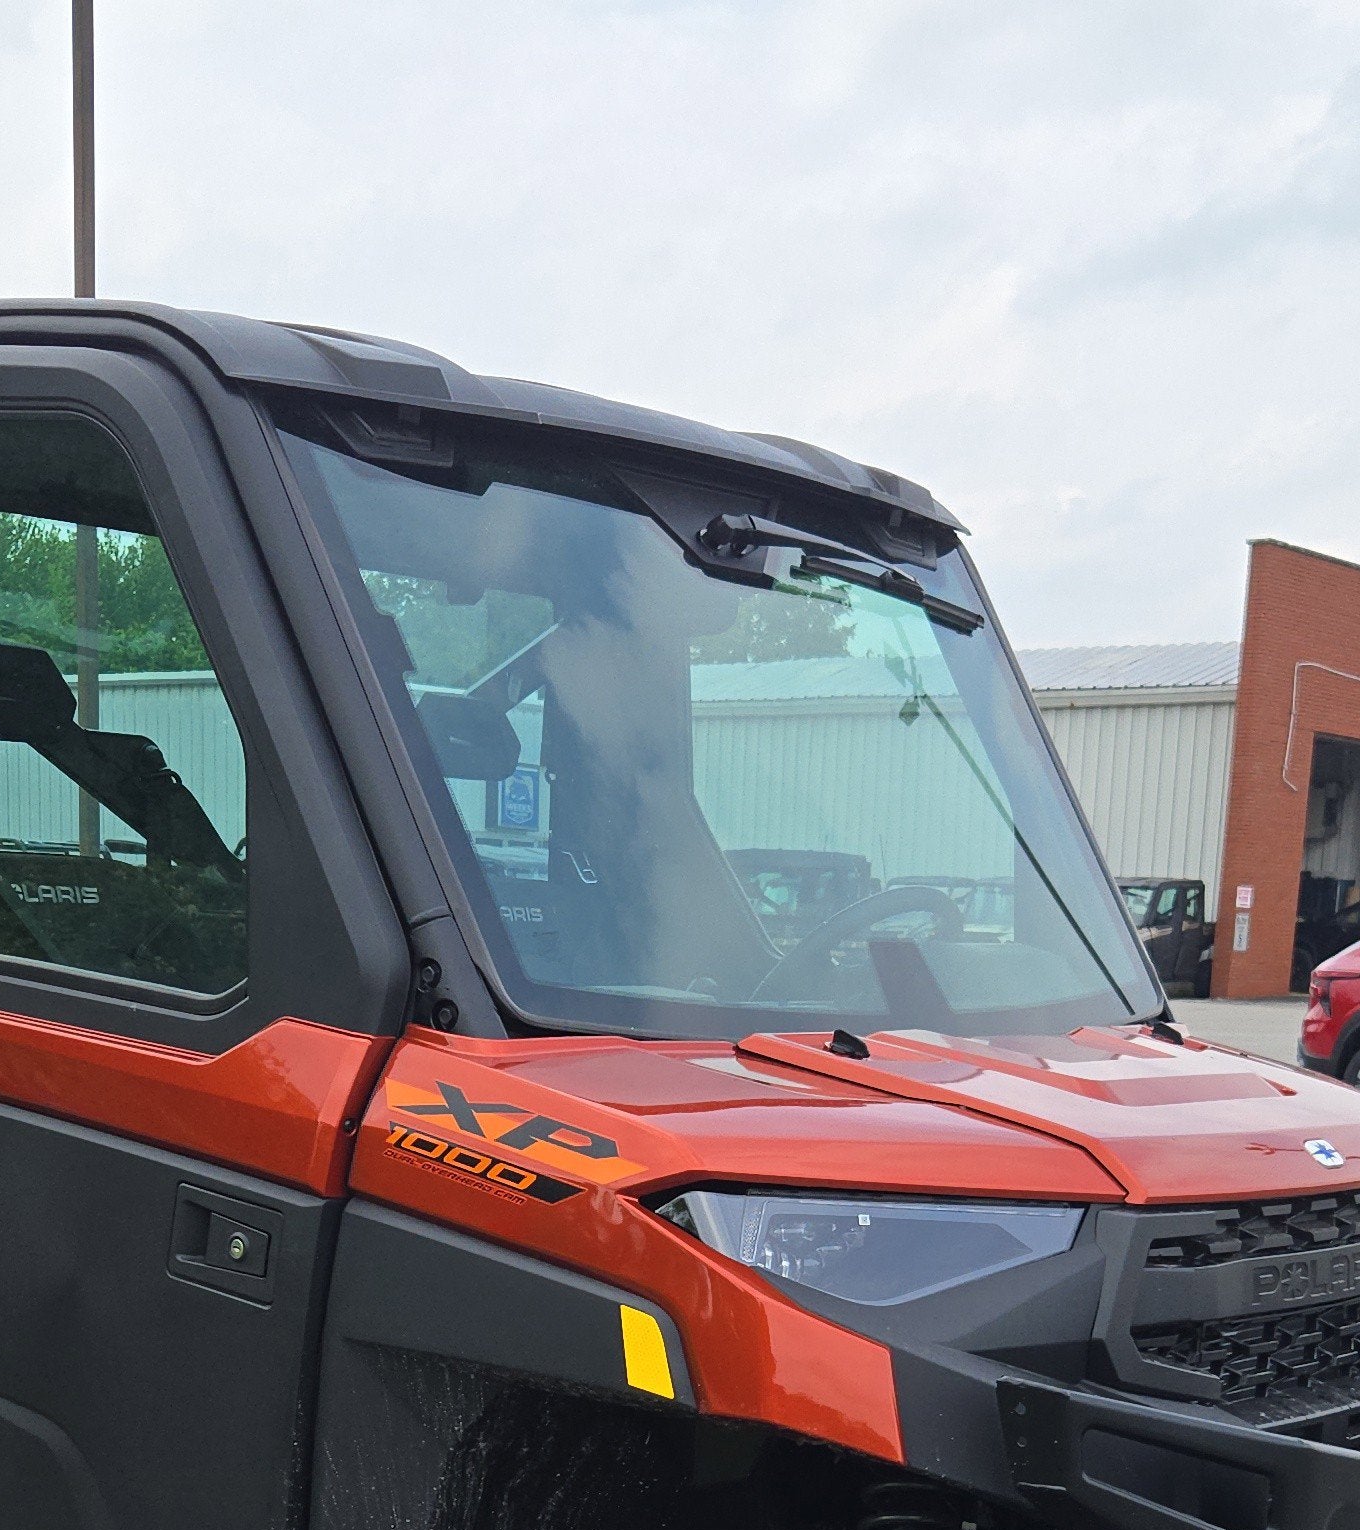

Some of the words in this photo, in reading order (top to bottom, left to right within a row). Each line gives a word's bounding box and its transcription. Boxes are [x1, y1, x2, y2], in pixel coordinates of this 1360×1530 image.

[11, 883, 100, 904] LARIS
[500, 906, 543, 922] ARIS
[392, 1080, 620, 1160] XP
[383, 1148, 416, 1165] DUAL
[421, 1162, 493, 1193] OVERHEAD
[494, 1190, 525, 1205] CAM
[385, 1126, 537, 1190] 1000
